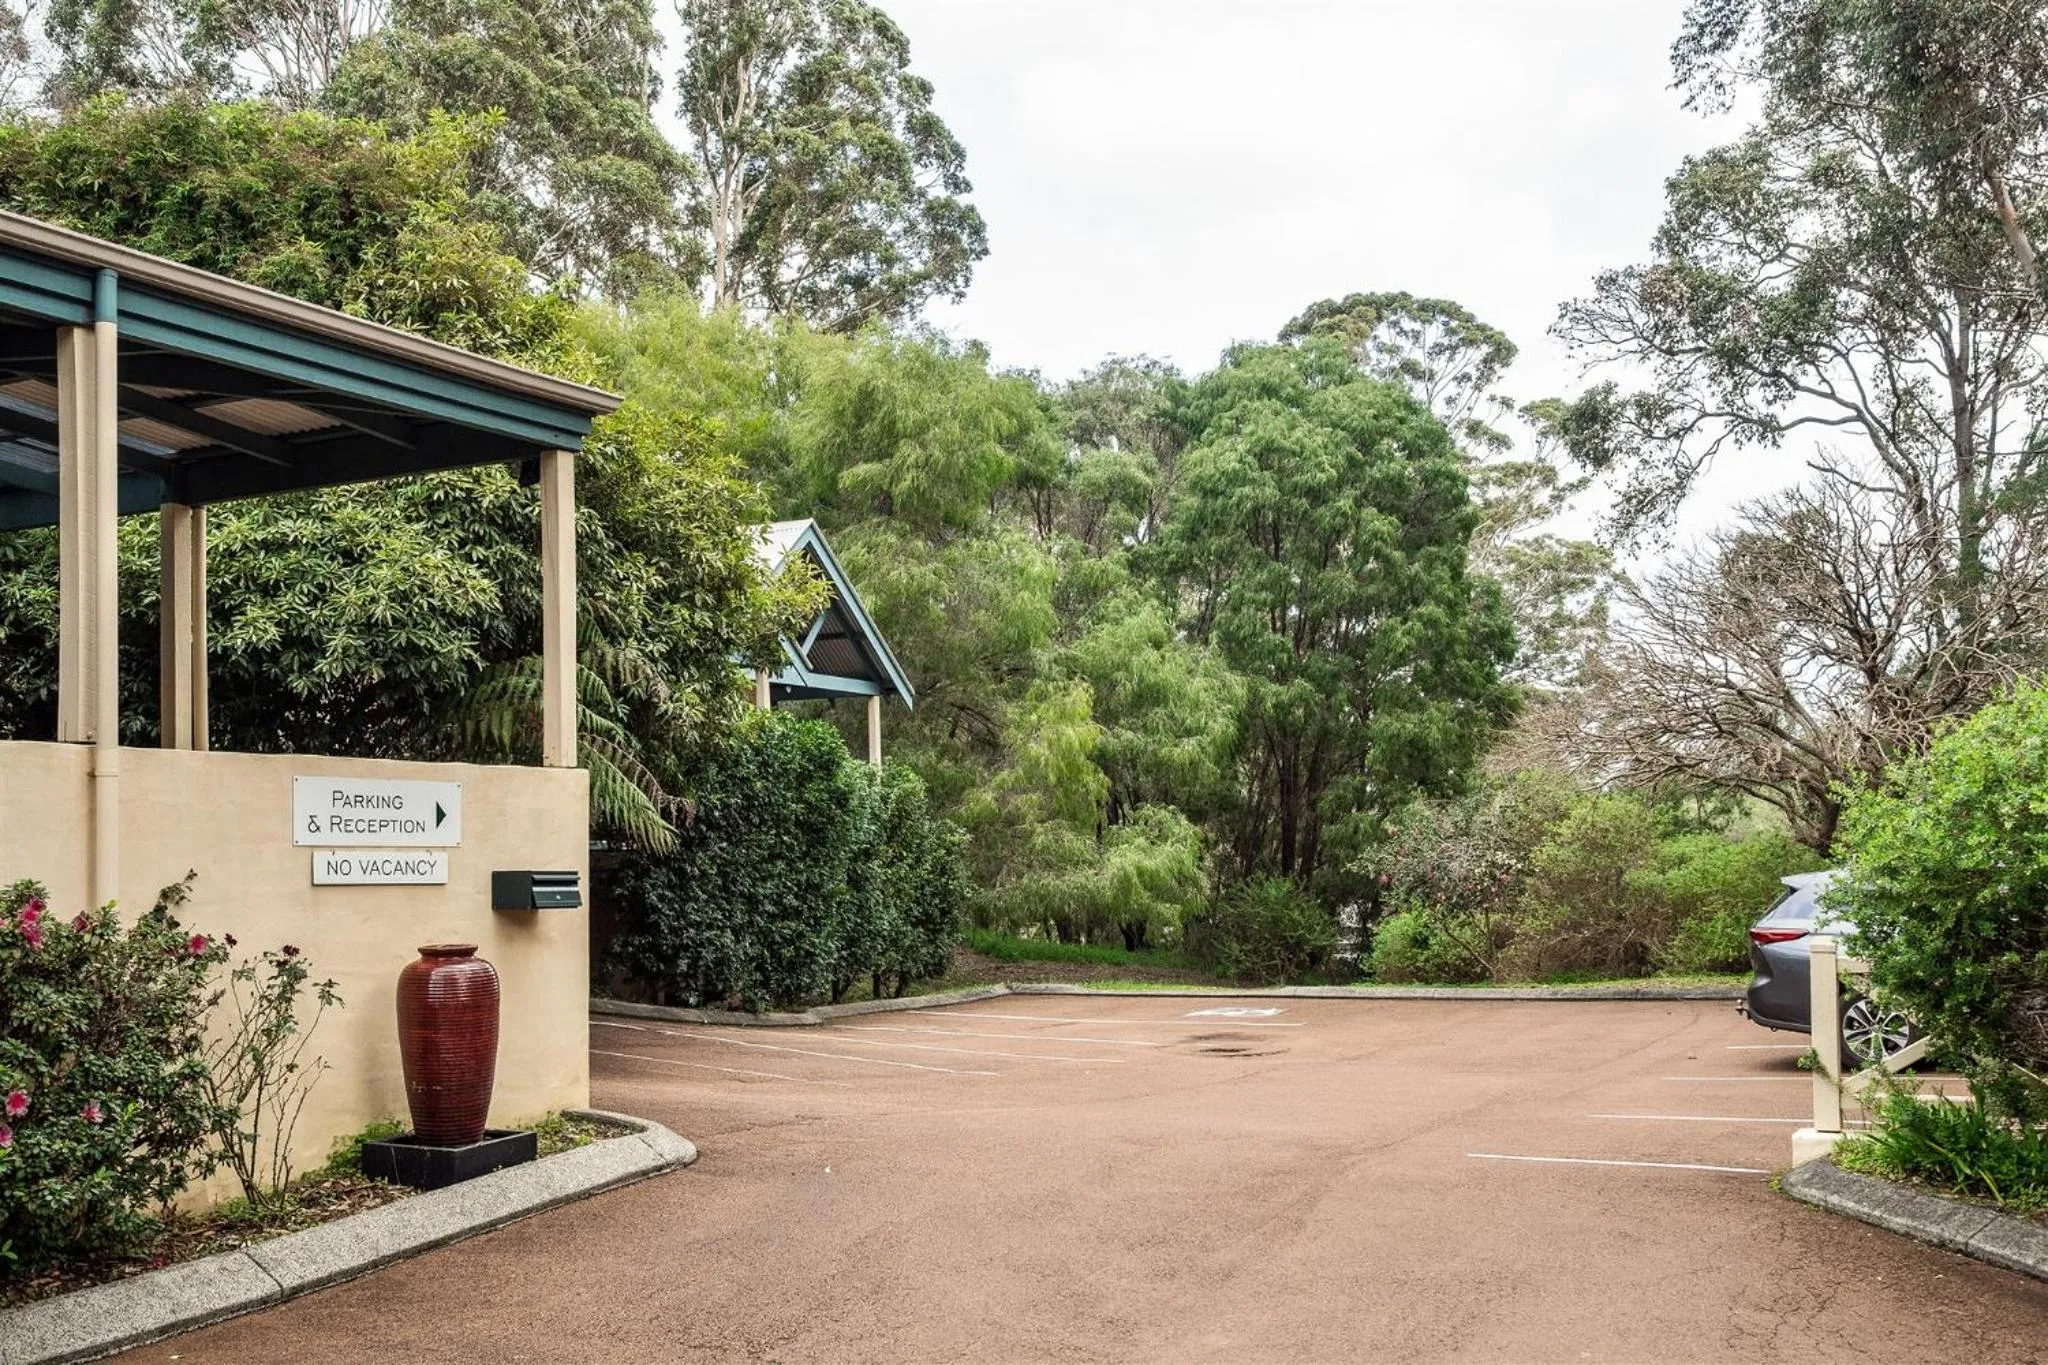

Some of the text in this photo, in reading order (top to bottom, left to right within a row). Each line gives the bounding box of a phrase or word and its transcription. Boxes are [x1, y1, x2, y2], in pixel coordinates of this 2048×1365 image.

[331, 790, 404, 810] PARKING
[307, 815, 426, 834] & RECEPTION
[327, 859, 438, 876] NO VACANCY
